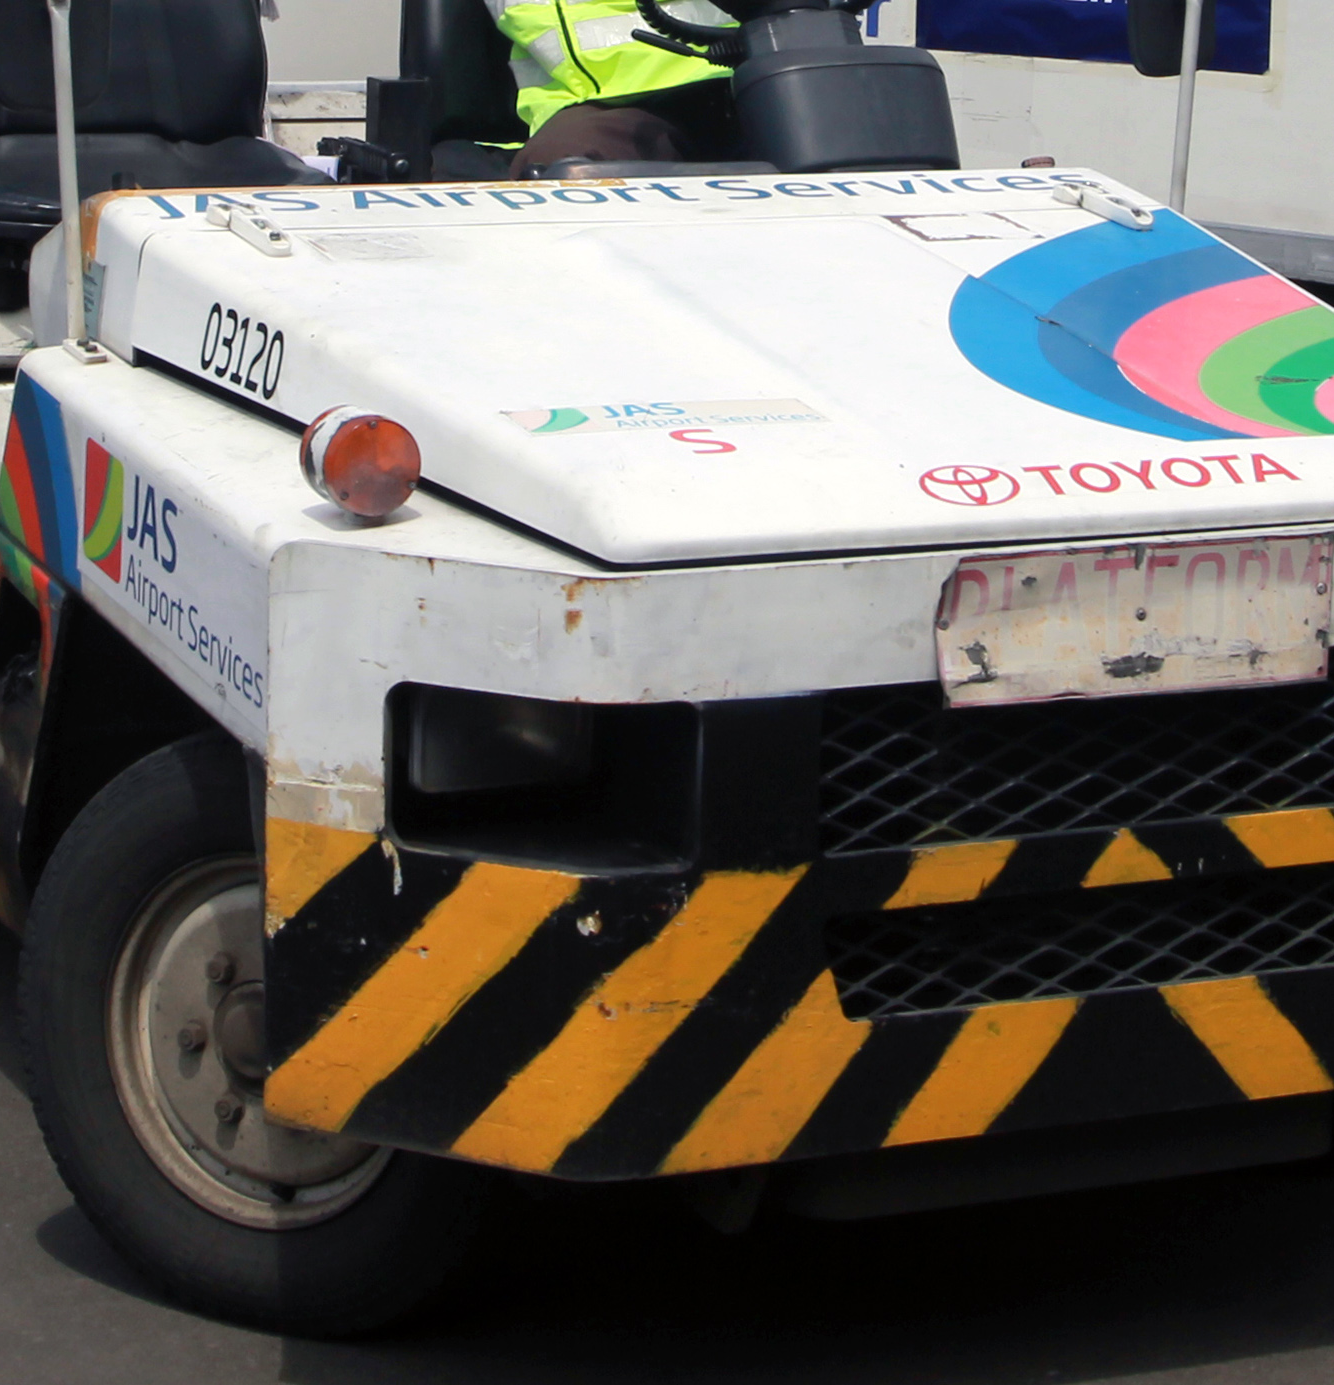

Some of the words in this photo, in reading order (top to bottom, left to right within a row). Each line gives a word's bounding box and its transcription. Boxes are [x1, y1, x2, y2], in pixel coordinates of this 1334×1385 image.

[146, 190, 320, 219] JAS
[353, 182, 700, 210] Airport
[705, 172, 1107, 201] Services
[201, 302, 284, 400] 03120
[602, 402, 686, 419] JAS
[616, 414, 704, 429] Airport
[709, 412, 823, 425] Services
[1024, 452, 1303, 496] TOYOTA
[127, 474, 178, 574] JAS
[125, 554, 185, 641] Airport
[187, 605, 264, 709] Services
